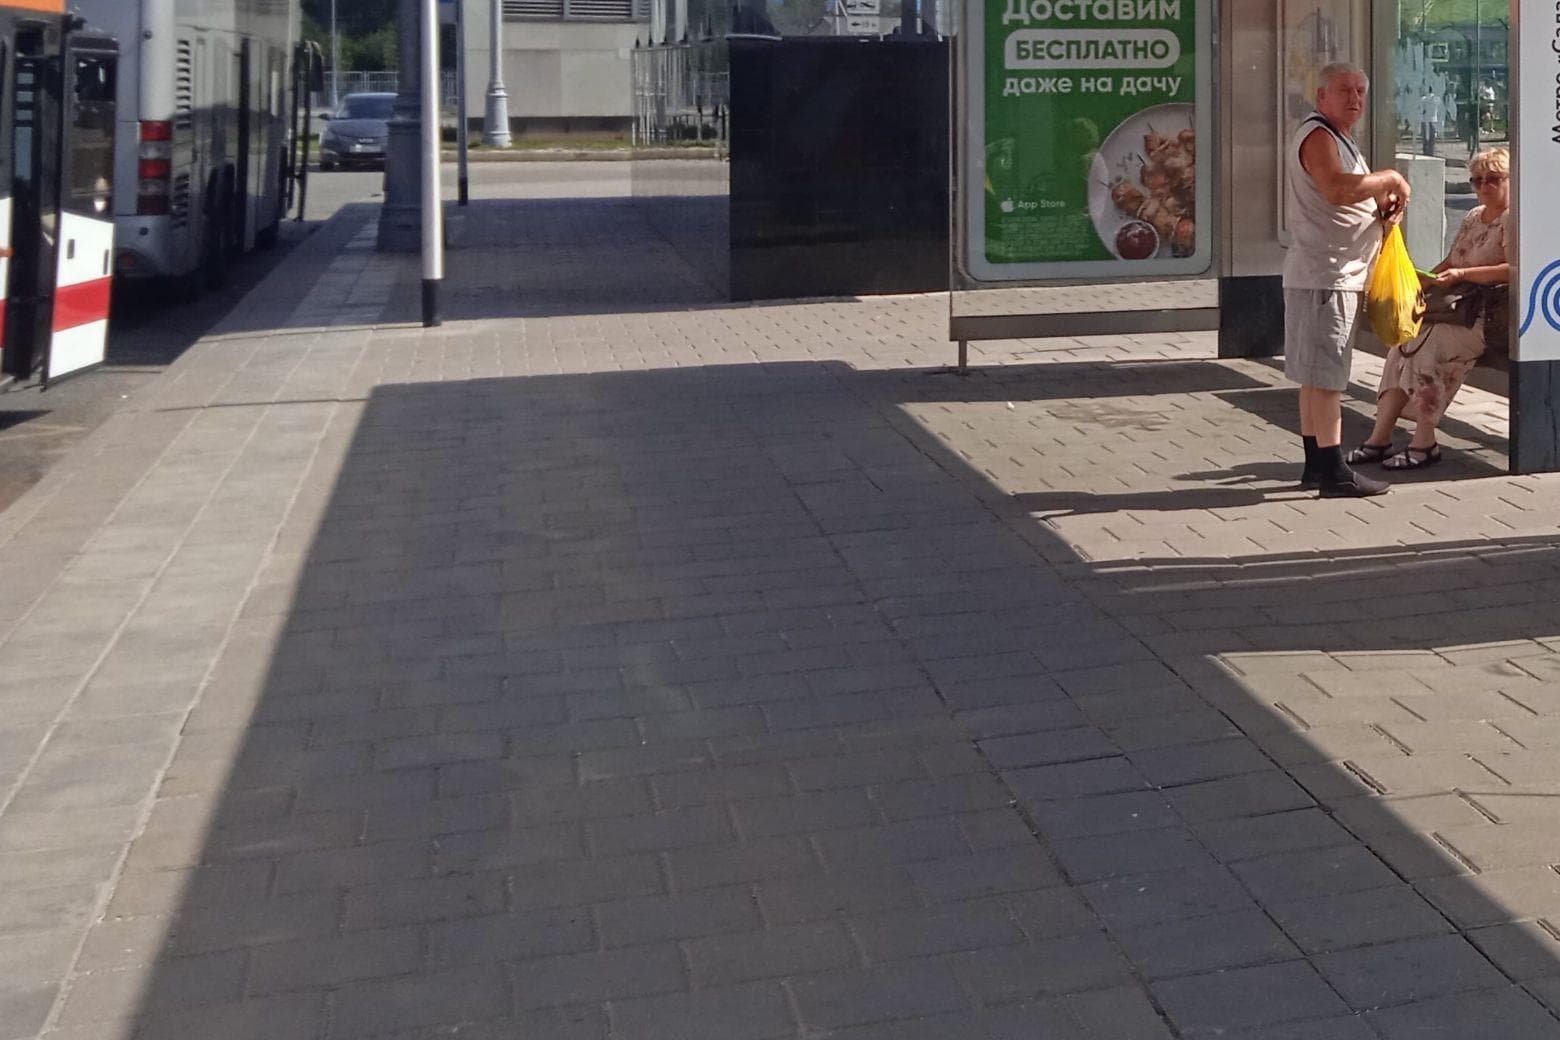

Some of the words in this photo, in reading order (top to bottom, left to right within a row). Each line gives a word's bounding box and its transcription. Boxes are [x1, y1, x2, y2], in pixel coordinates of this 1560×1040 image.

[1016, 38, 1170, 61] БЕСПЛАТНО
[1002, 76, 1073, 97] даже
[1080, 76, 1113, 93] на
[1119, 76, 1182, 97] дачу
[1018, 200, 1038, 210] App
[1040, 199, 1066, 209] Store
